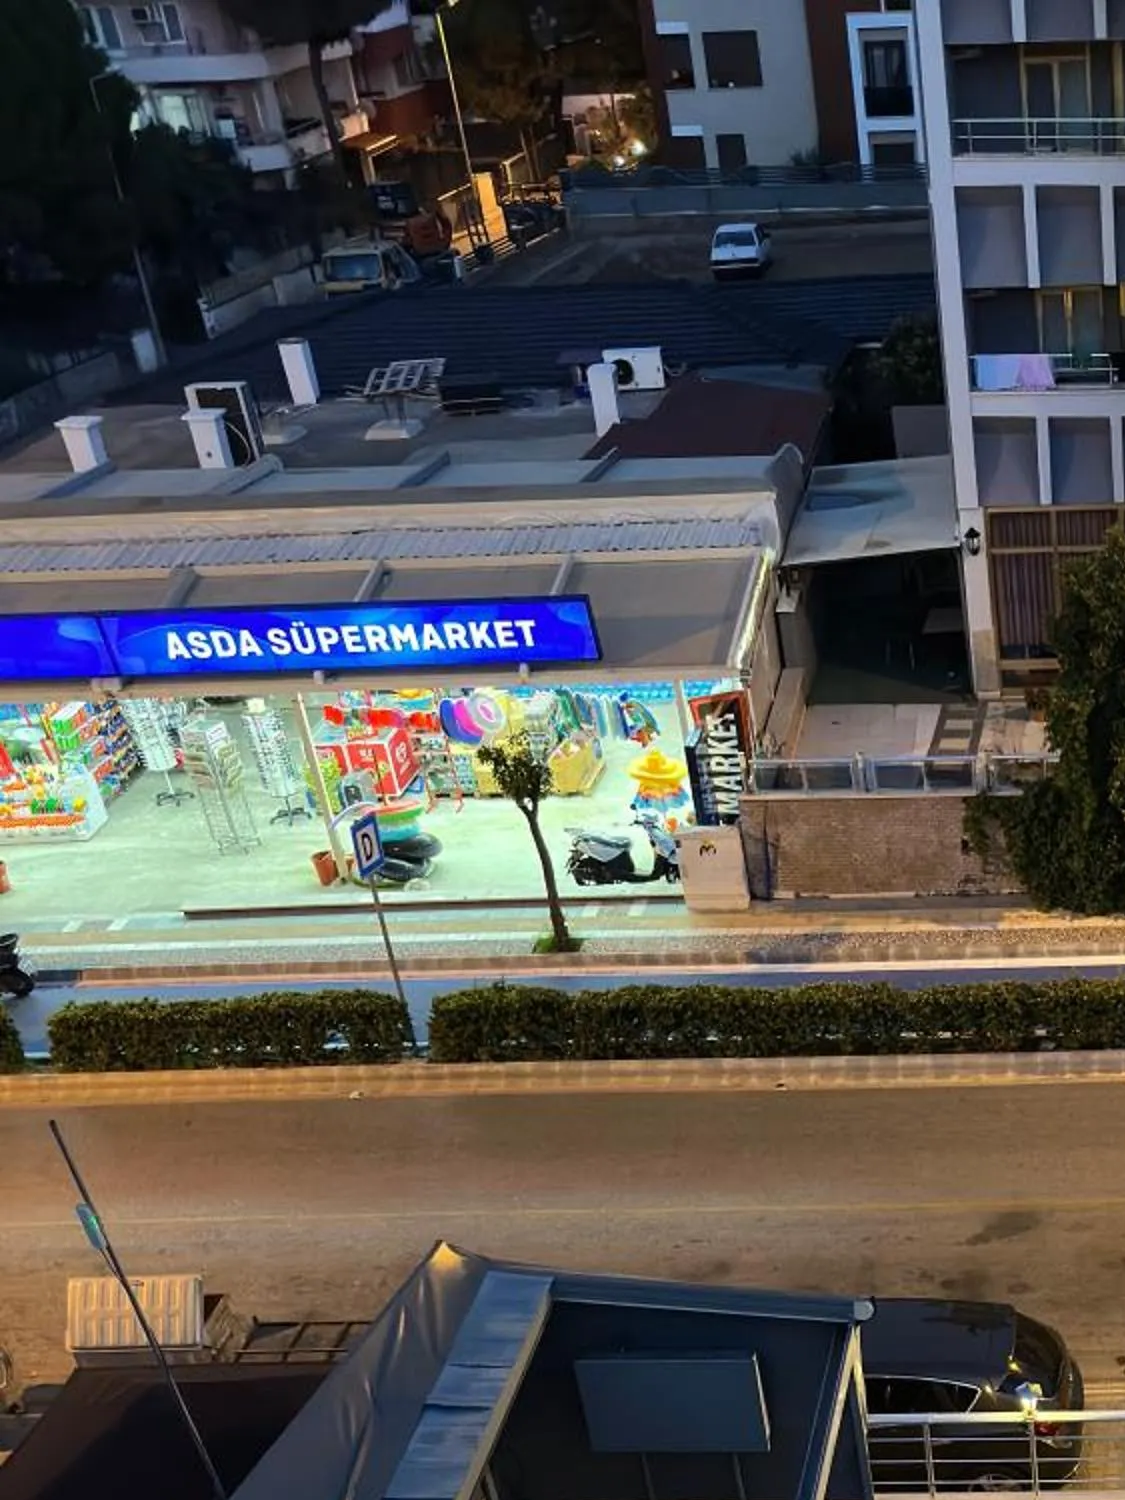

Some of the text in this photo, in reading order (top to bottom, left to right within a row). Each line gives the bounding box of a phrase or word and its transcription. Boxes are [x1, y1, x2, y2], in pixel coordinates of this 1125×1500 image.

[166, 620, 537, 661] ASDA SÜPERMARKET
[361, 832, 374, 862] D
